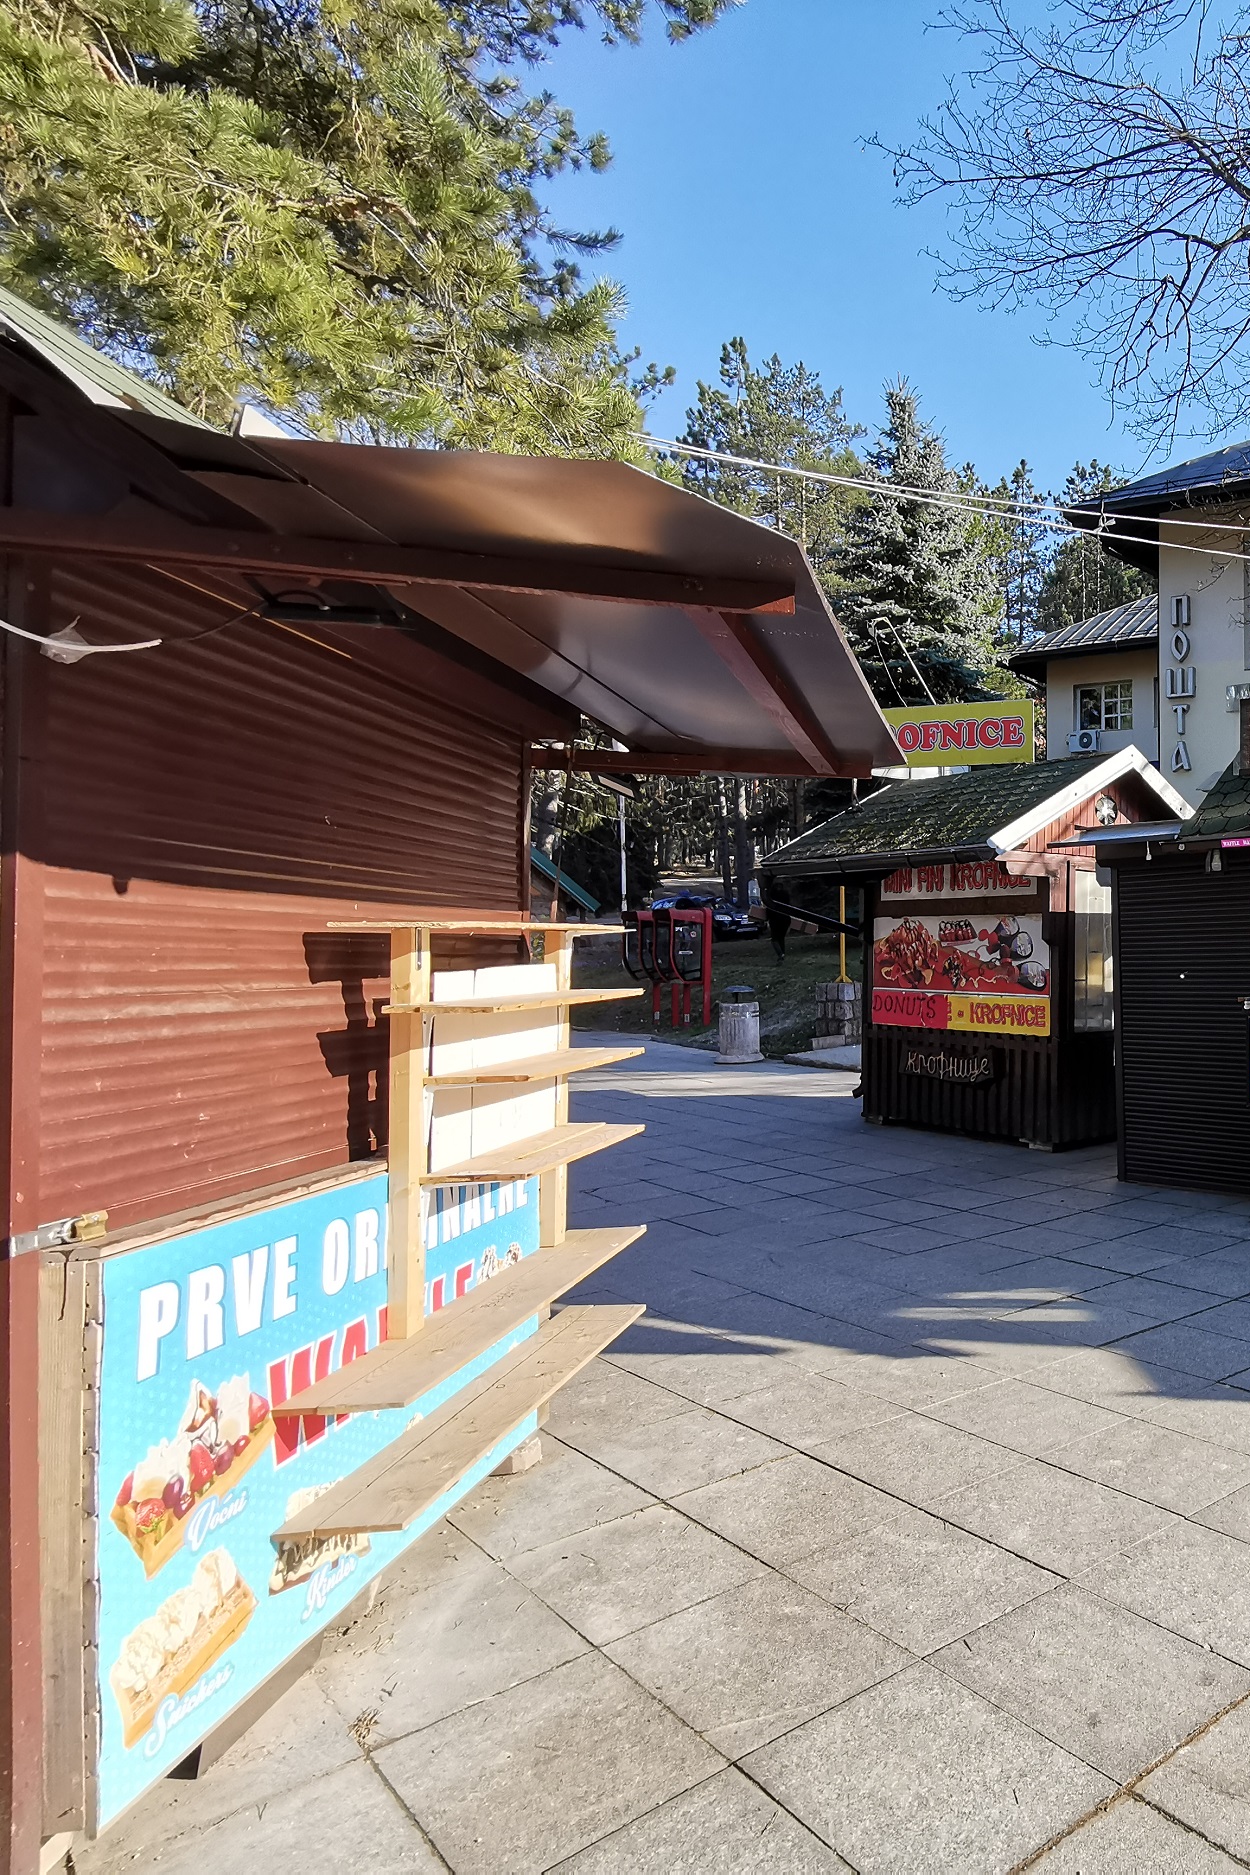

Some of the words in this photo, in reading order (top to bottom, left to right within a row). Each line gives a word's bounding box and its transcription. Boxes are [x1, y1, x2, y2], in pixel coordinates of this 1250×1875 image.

[1165, 594, 1197, 773] ПОШТА
[890, 716, 1025, 752] OFNICE
[873, 994, 936, 1019] DONUTS
[969, 1002, 1046, 1028] KROFNICE
[137, 1233, 299, 1383] PRVE
[302, 1556, 356, 1620] Kinder
[144, 1663, 234, 1757] Snickers
